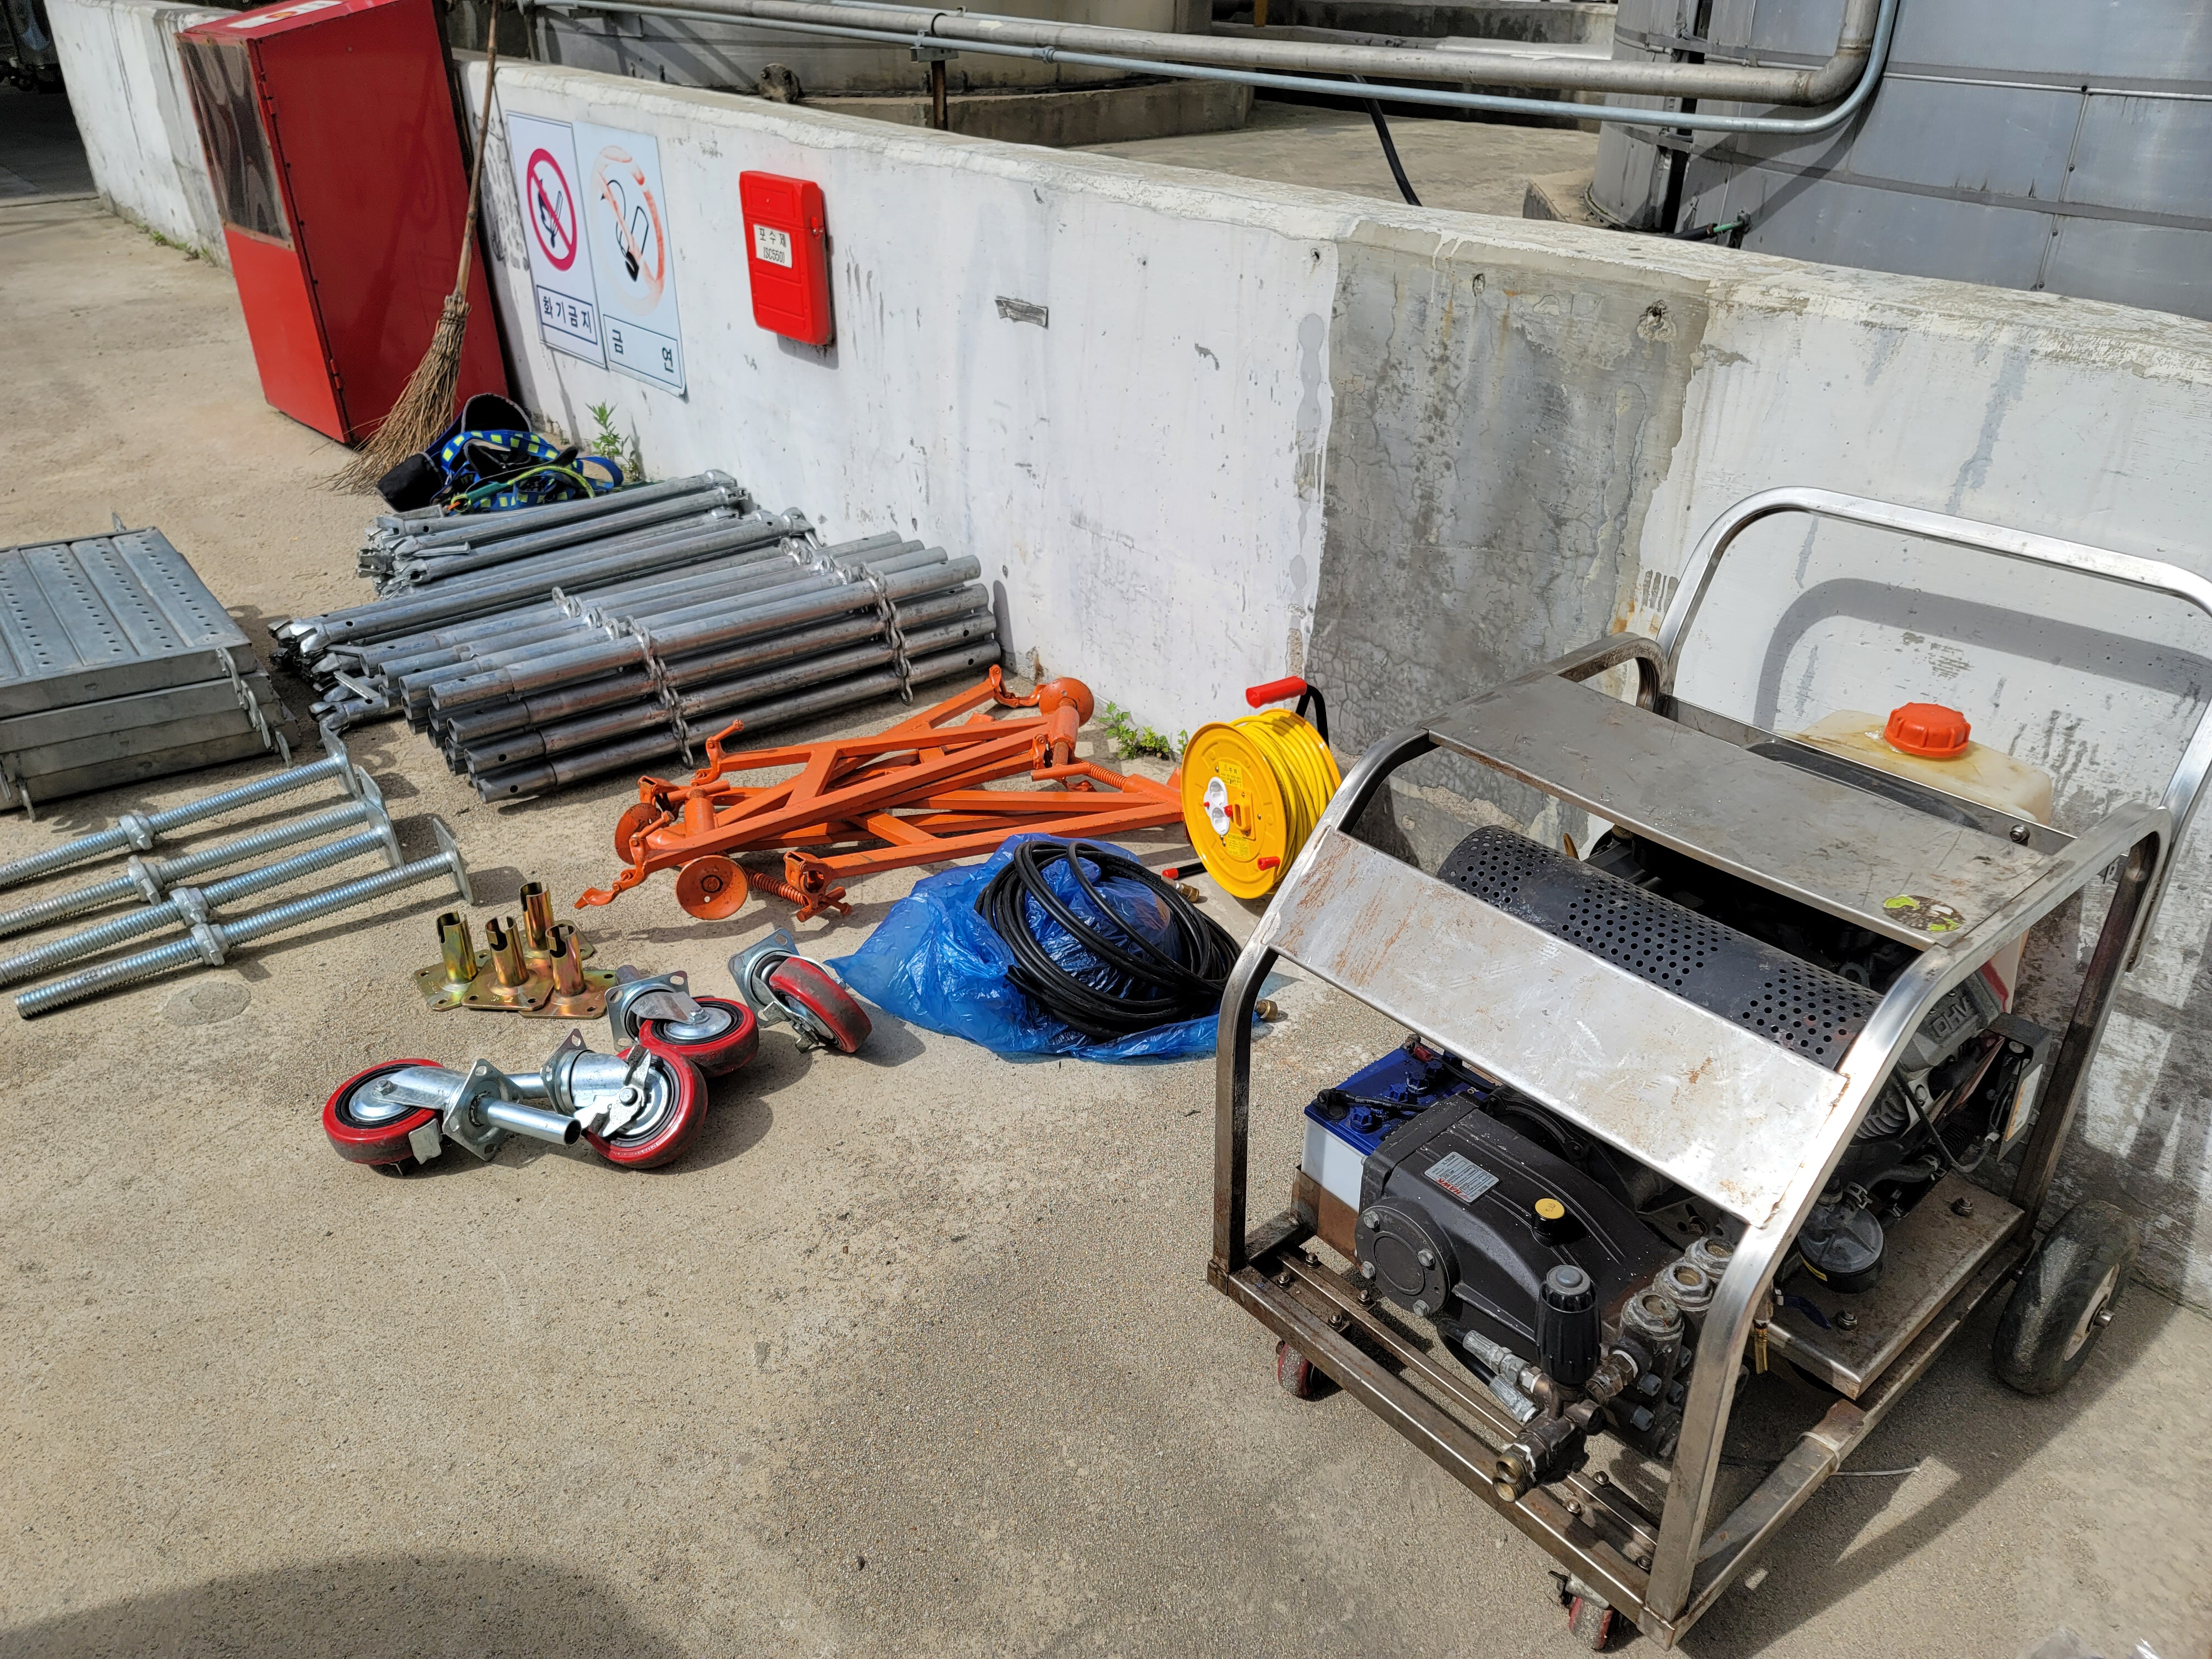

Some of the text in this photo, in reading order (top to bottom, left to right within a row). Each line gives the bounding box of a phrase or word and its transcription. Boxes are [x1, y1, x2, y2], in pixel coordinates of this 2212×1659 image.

[542, 296, 592, 334] 화기금지
[1932, 997, 1971, 1037] OHV
[1437, 1178, 1462, 1195] HAWK
